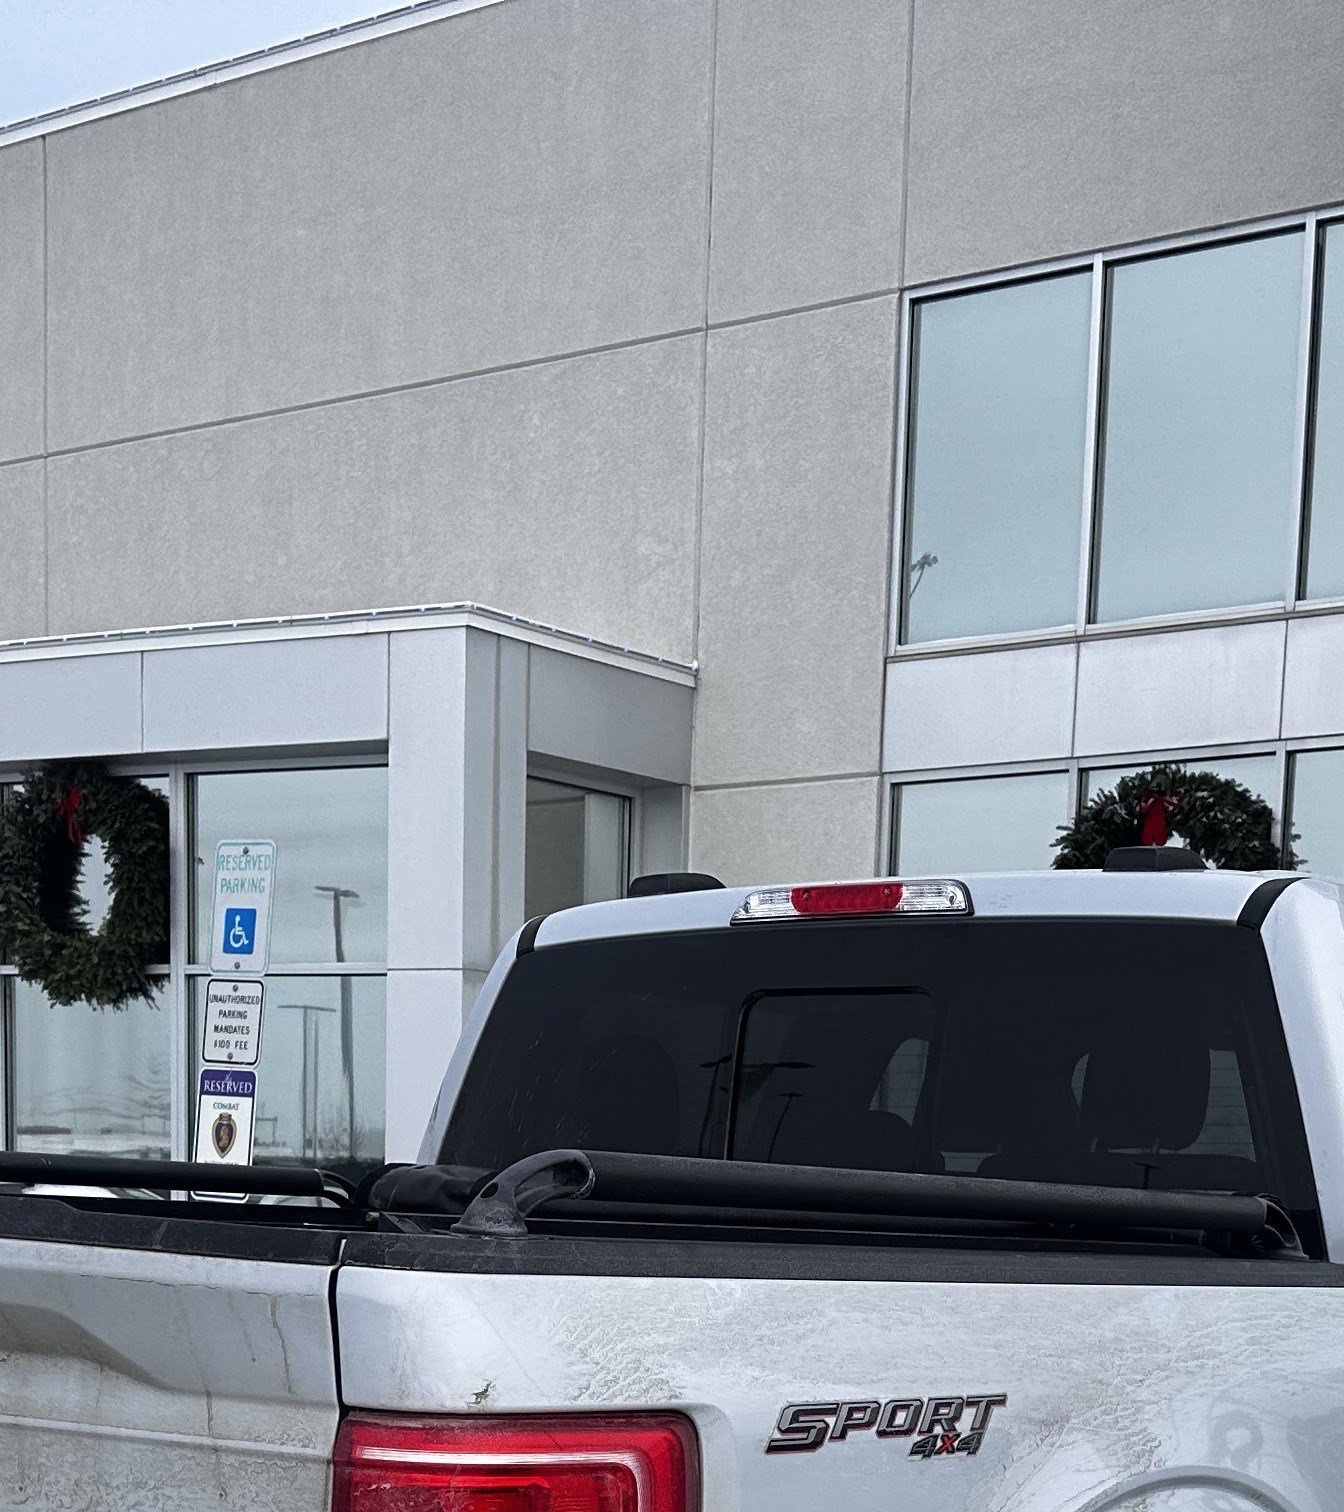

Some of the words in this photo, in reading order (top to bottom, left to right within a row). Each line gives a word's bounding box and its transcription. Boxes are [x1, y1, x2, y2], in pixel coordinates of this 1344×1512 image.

[217, 853, 272, 872] RESERVED
[220, 877, 266, 894] PARKING
[209, 993, 261, 1006] UNAUTHORIZED
[218, 1009, 248, 1020] PARKING
[213, 1023, 251, 1036] MANDATES
[234, 1040, 249, 1051] FEE
[203, 1079, 253, 1095] RESERVED
[765, 1393, 1008, 1454] SPORT
